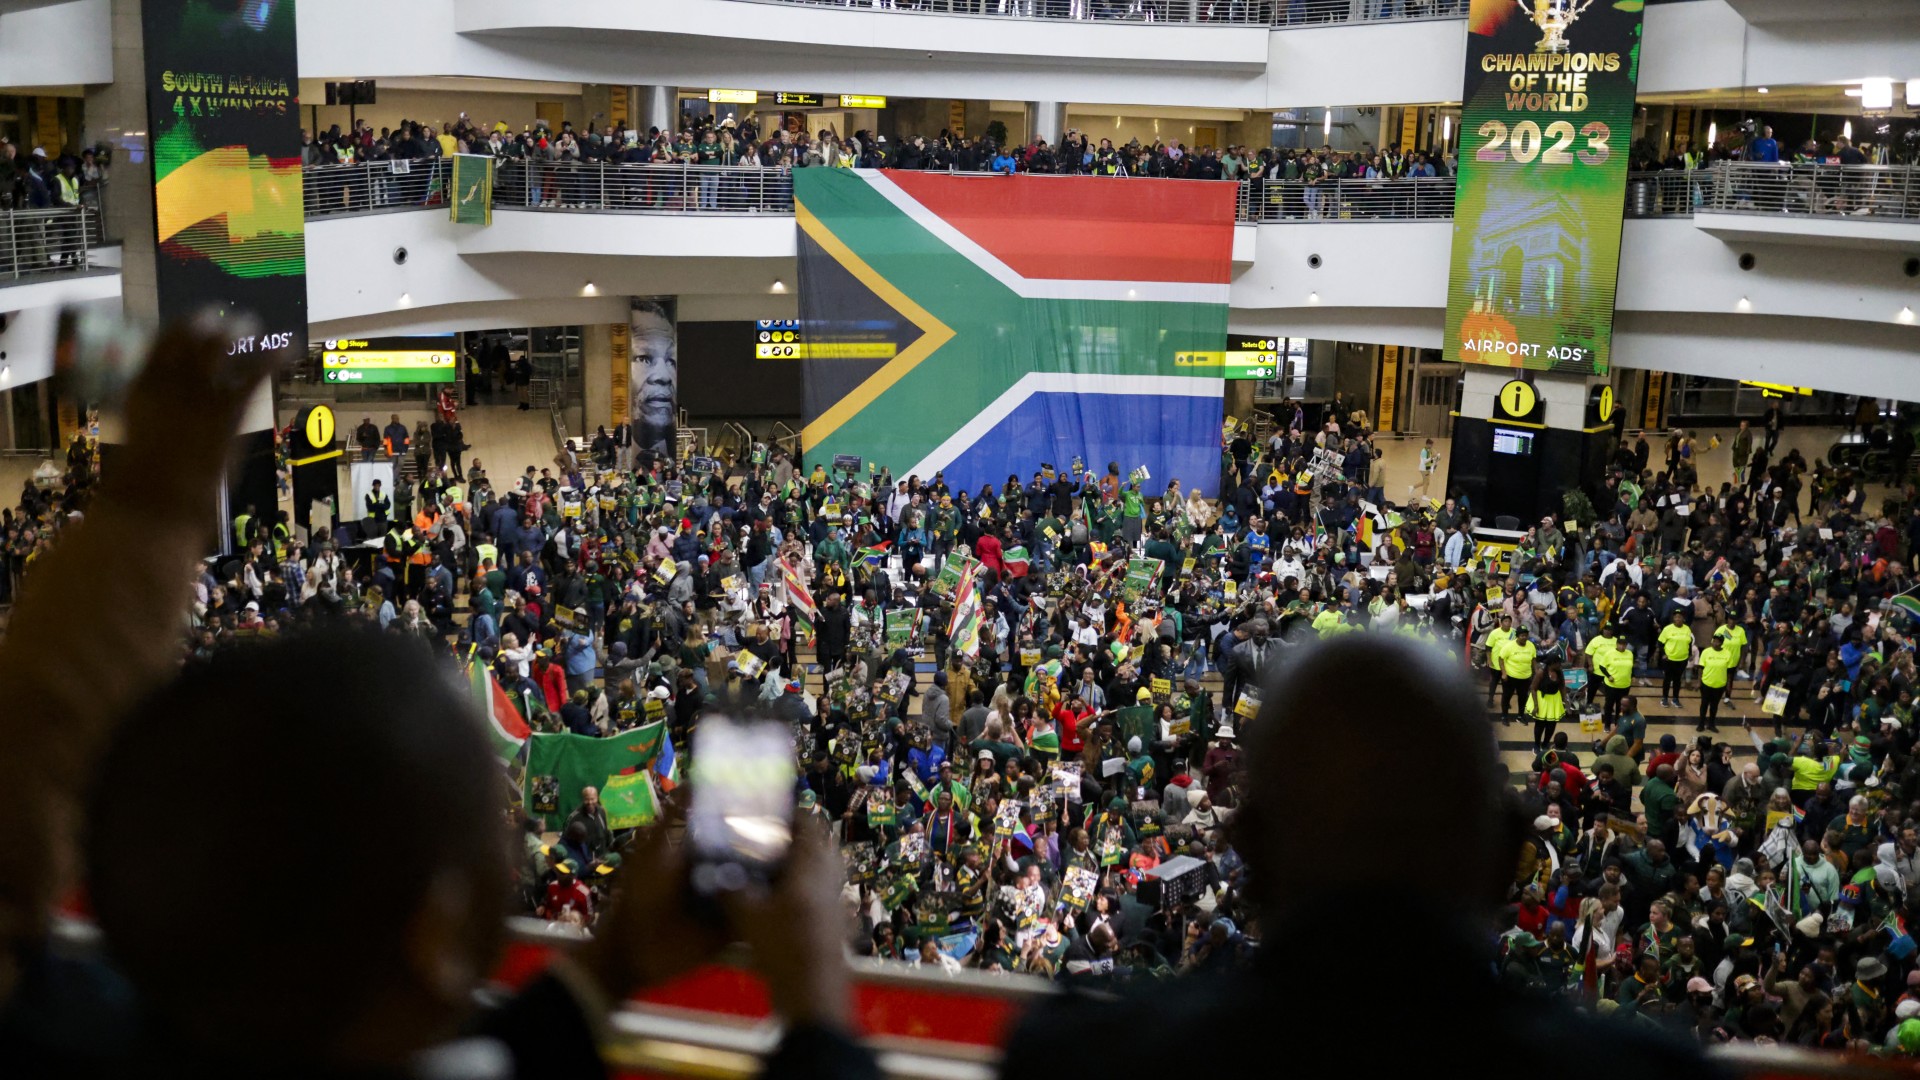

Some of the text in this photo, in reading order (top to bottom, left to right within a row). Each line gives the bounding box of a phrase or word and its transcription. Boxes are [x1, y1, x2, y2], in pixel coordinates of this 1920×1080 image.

[1481, 52, 1621, 73] CHAMPIONS
[162, 70, 289, 97] SOUTH AFRICA
[1509, 73, 1588, 92] OF THE
[172, 95, 185, 117] 4
[189, 96, 203, 117] X
[1504, 92, 1589, 112] WORLD
[1475, 119, 1611, 166] 2023
[348, 340, 369, 348] Shops
[1464, 338, 1583, 362] AIRPORT ADS
